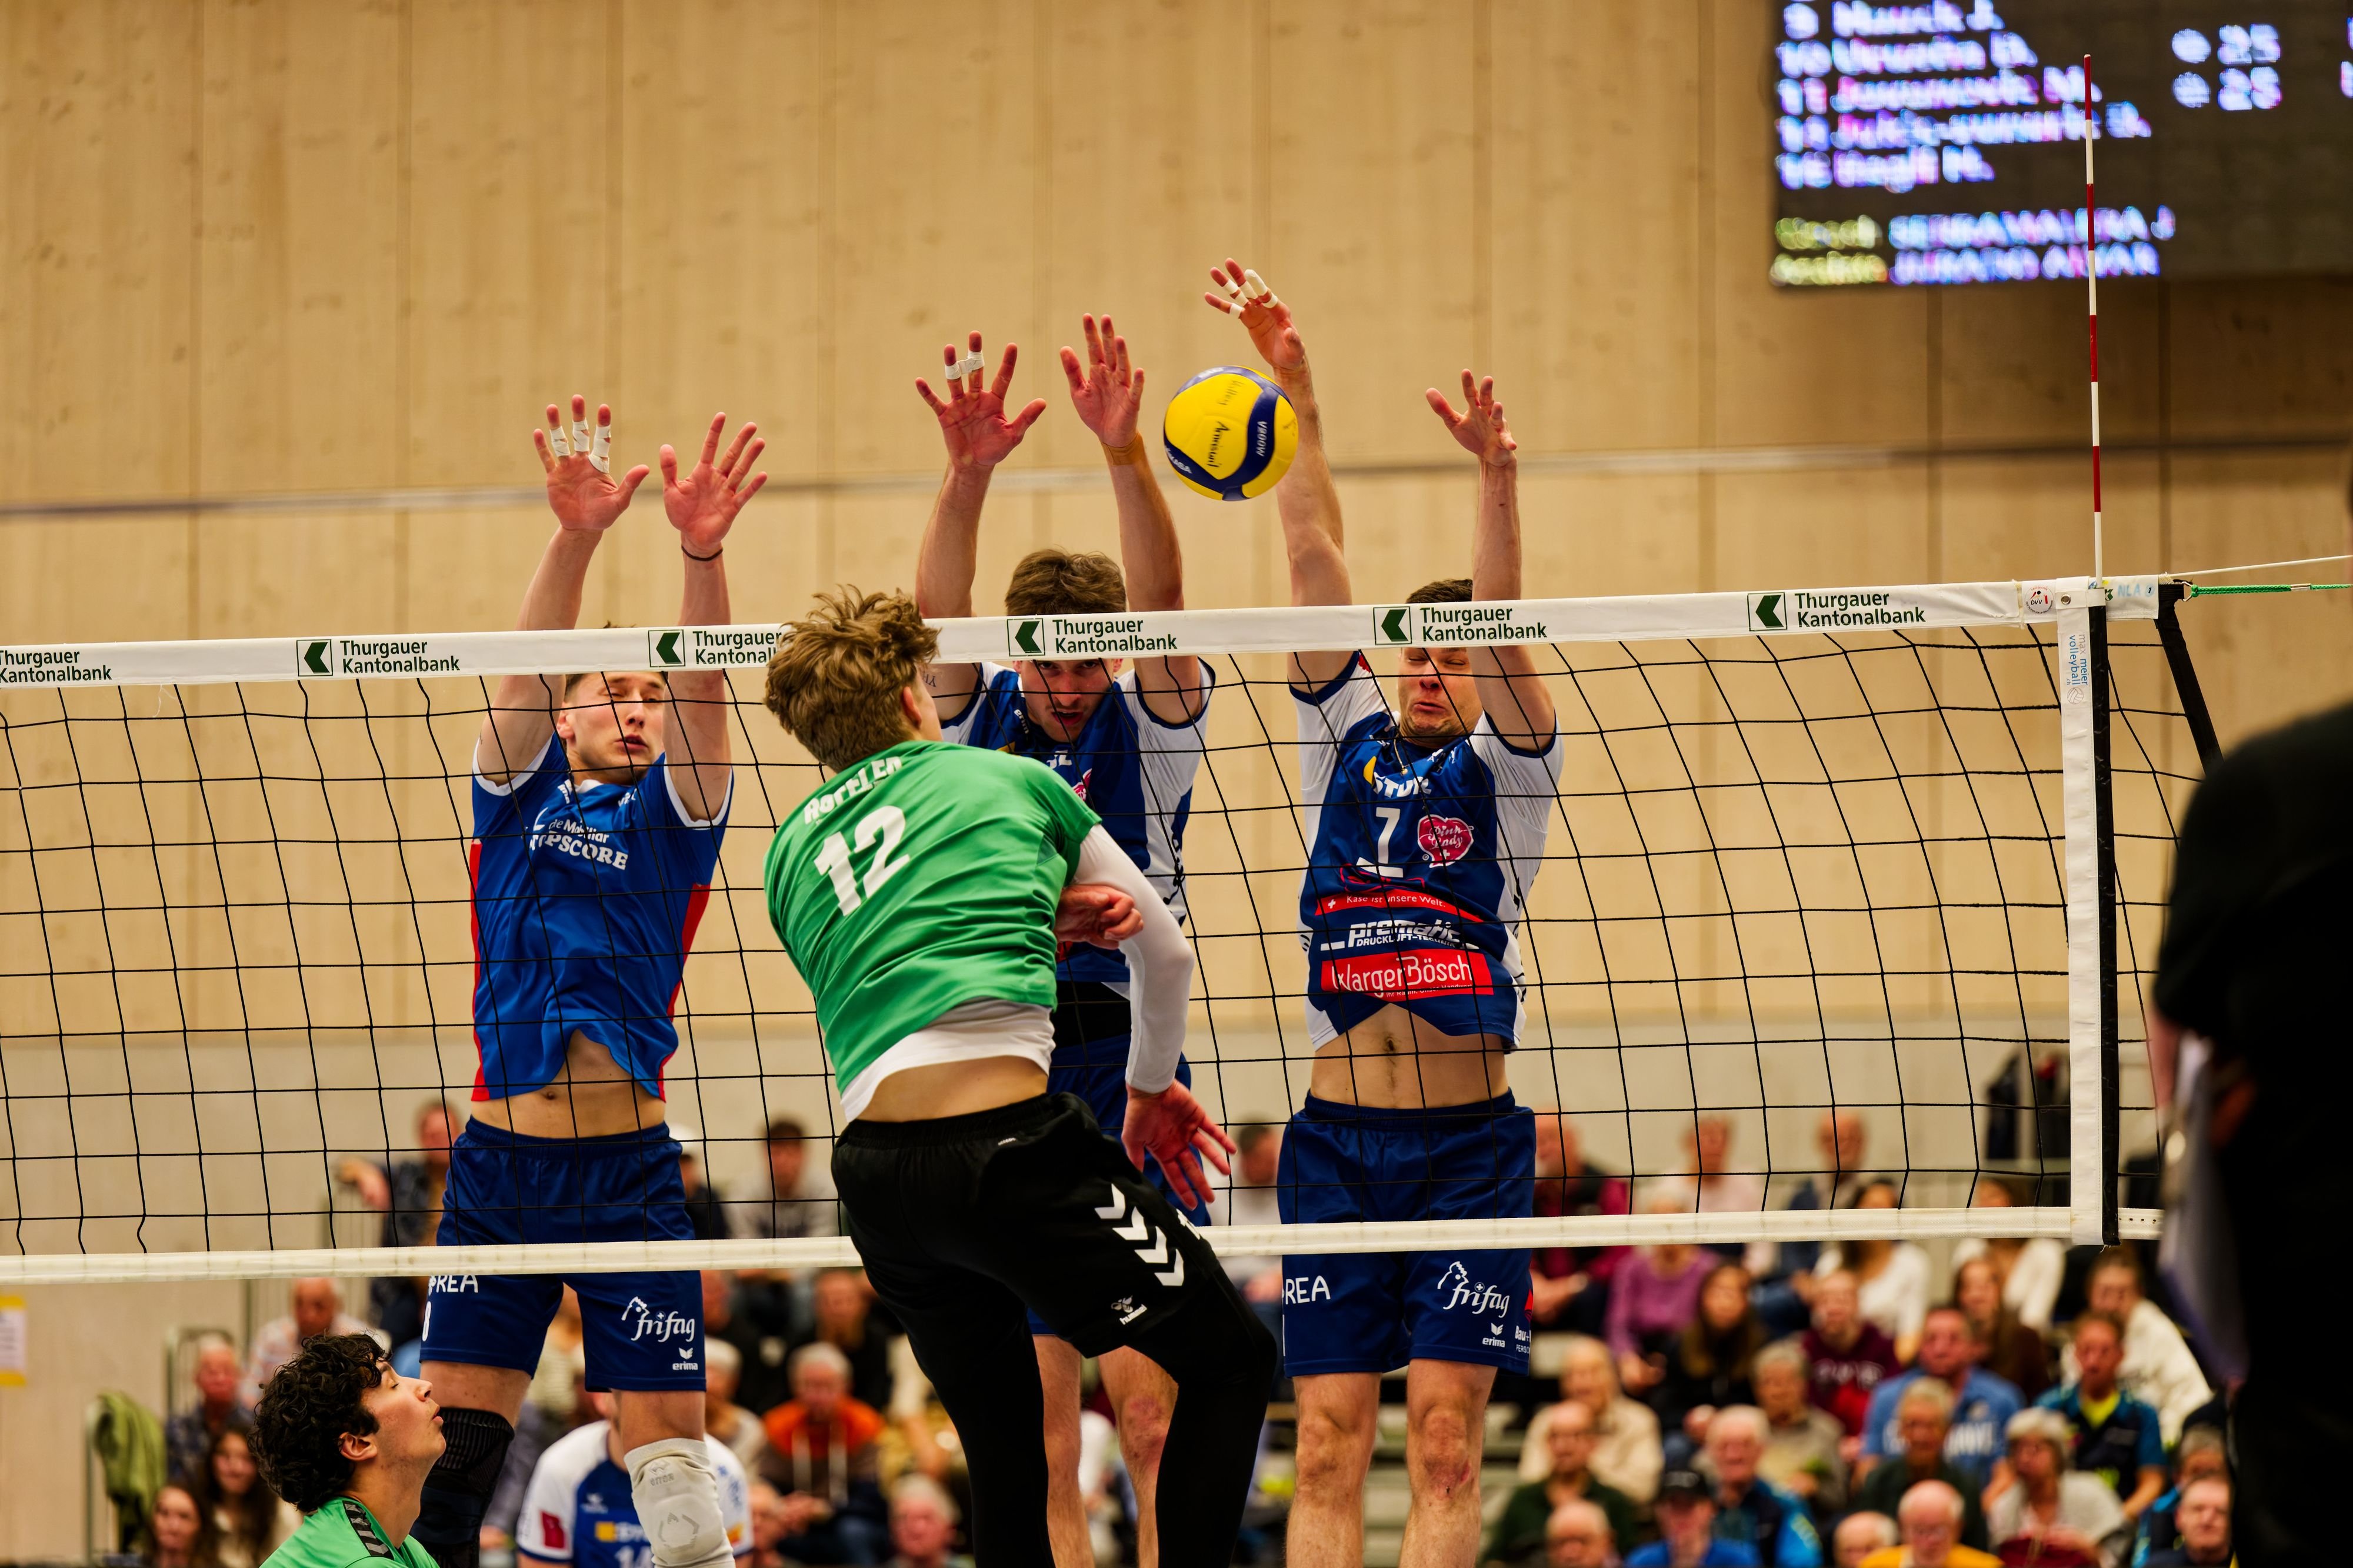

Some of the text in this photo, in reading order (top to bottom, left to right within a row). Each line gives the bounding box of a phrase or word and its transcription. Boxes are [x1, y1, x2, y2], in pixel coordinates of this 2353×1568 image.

[2118, 583, 2140, 597] NLA
[1795, 593, 1889, 610] Thurgauer
[1420, 608, 1512, 625] Thurgauer
[1798, 607, 1926, 628] Kantonalbank
[1052, 619, 1143, 637] Thurgauer
[1422, 622, 1547, 641] Kantonalbank
[340, 640, 428, 658] Thurgauer
[692, 630, 782, 649] Thurgauer
[1055, 634, 1178, 653] Kantonalbank
[342, 655, 461, 673] Kantonalbank
[2068, 635, 2081, 685] volleyball
[0, 664, 112, 683] Kantonalbank
[2079, 658, 2089, 685] meier
[1375, 806, 1401, 865] 7
[814, 805, 910, 917] 12
[1419, 895, 1446, 908] Welt.
[1443, 1285, 1510, 1318] frifag
[631, 1310, 695, 1343] frifag
[1482, 1336, 1505, 1349] erima
[672, 1361, 698, 1371] erima
